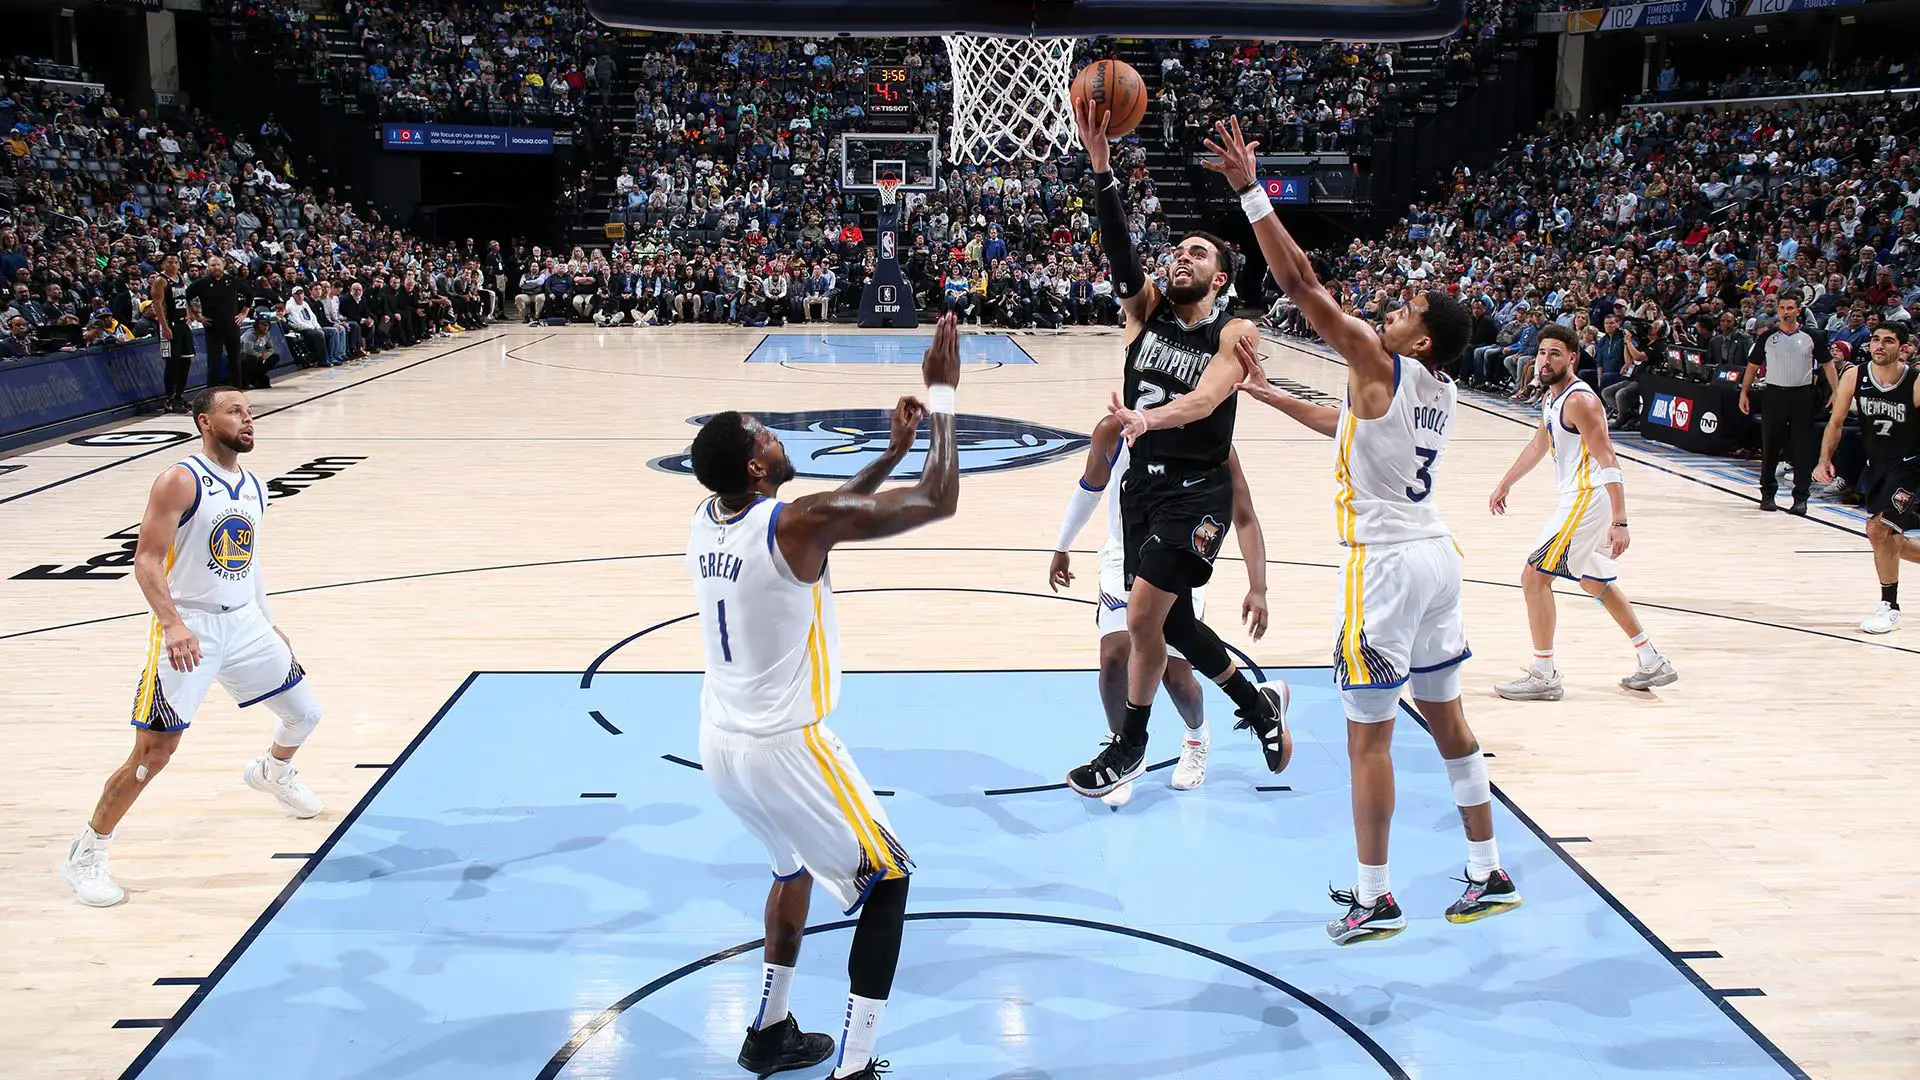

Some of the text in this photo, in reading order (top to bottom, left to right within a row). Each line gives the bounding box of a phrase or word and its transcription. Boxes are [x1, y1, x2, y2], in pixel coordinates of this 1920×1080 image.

[1647, 2, 1688, 15] TIMEOUTS: 2
[1611, 8, 1633, 28] 102
[1646, 15, 1669, 25] FOULS:
[881, 69, 905, 81] 3:56
[393, 131, 421, 140] IOA
[512, 136, 549, 145] ioausa.com
[875, 305, 900, 313] GET THE APP
[1652, 399, 1668, 419] NBA
[1860, 396, 1906, 422] MEMPHIS
[1414, 406, 1449, 436] POOLE
[1873, 420, 1893, 436] 7
[1405, 446, 1437, 503] 3
[211, 507, 238, 525] GOLDEN
[236, 529, 251, 545] 30
[699, 552, 744, 583] GREEN
[717, 599, 733, 663] 1
